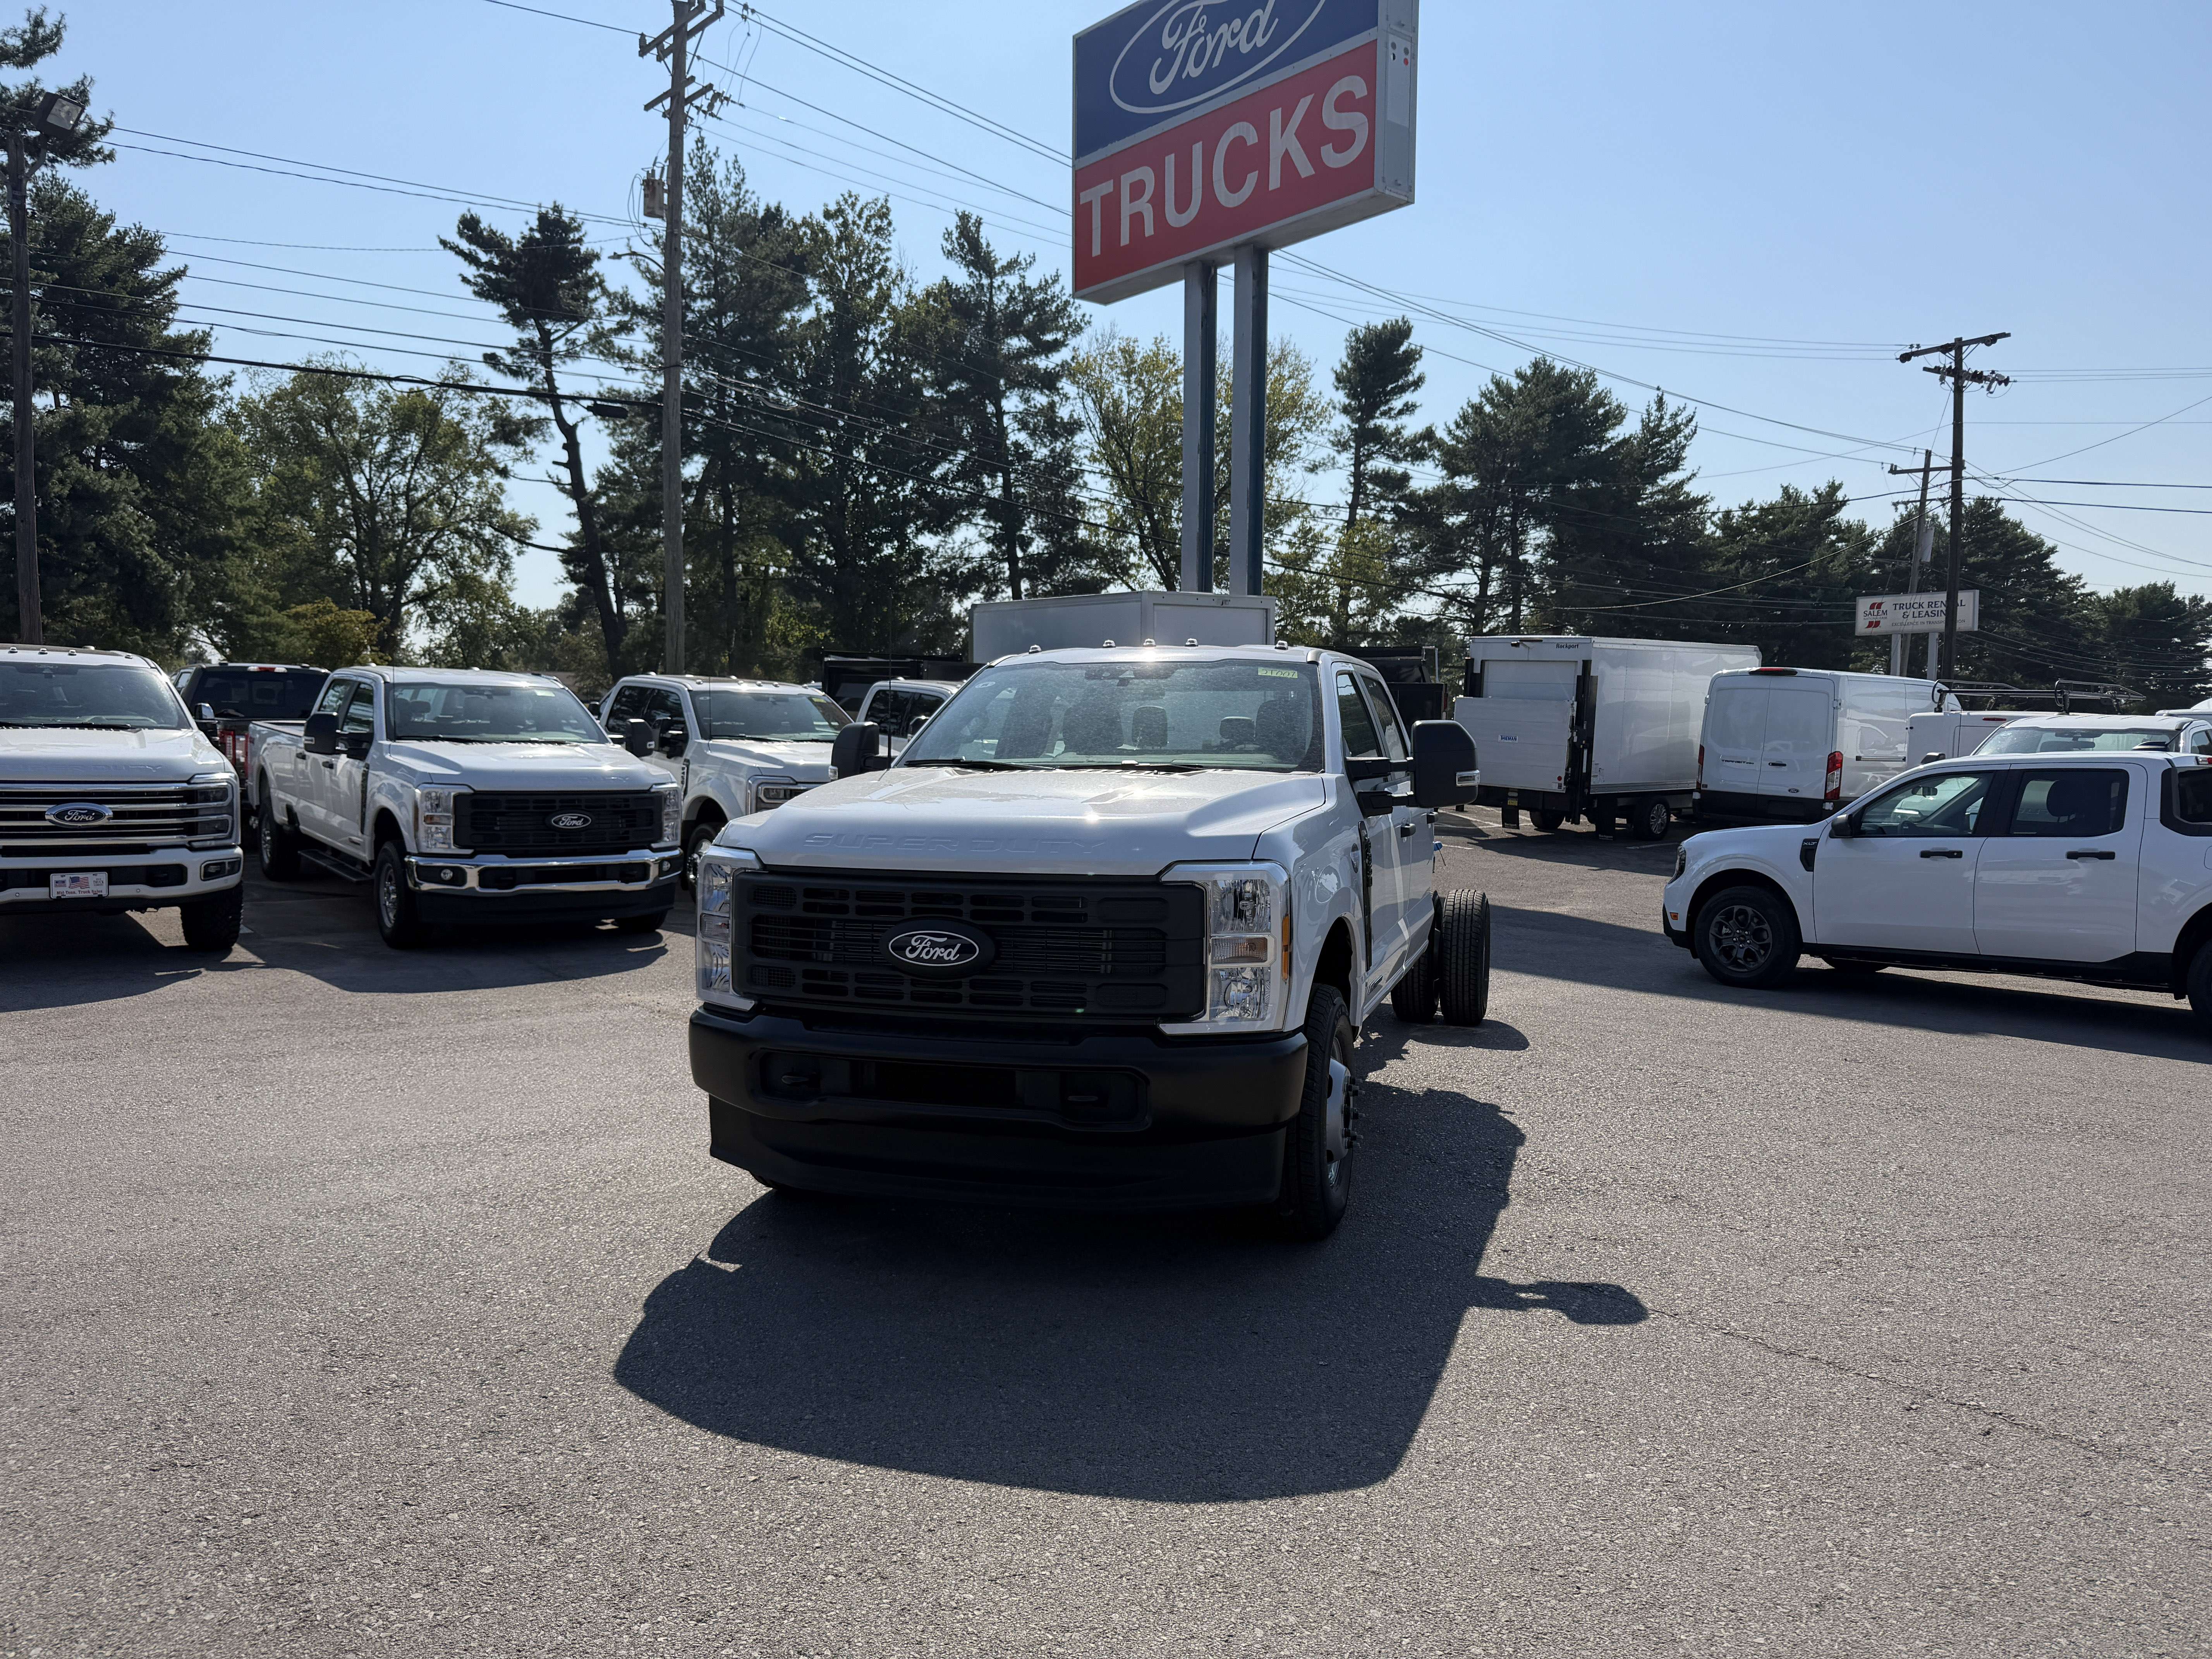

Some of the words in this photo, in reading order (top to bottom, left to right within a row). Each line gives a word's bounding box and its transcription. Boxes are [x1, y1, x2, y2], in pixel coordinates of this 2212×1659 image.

[1149, 0, 1279, 94] Ford
[1080, 75, 1369, 257] TRUCKS
[1893, 602, 1925, 610] TRUCK
[1927, 599, 1966, 608] RENL
[1912, 610, 1946, 618] LEASIN
[64, 809, 95, 821] Ford
[559, 816, 584, 826] Ford
[804, 833, 959, 851] SUPER
[969, 838, 1108, 854] DUTY
[905, 935, 961, 961] Ford
